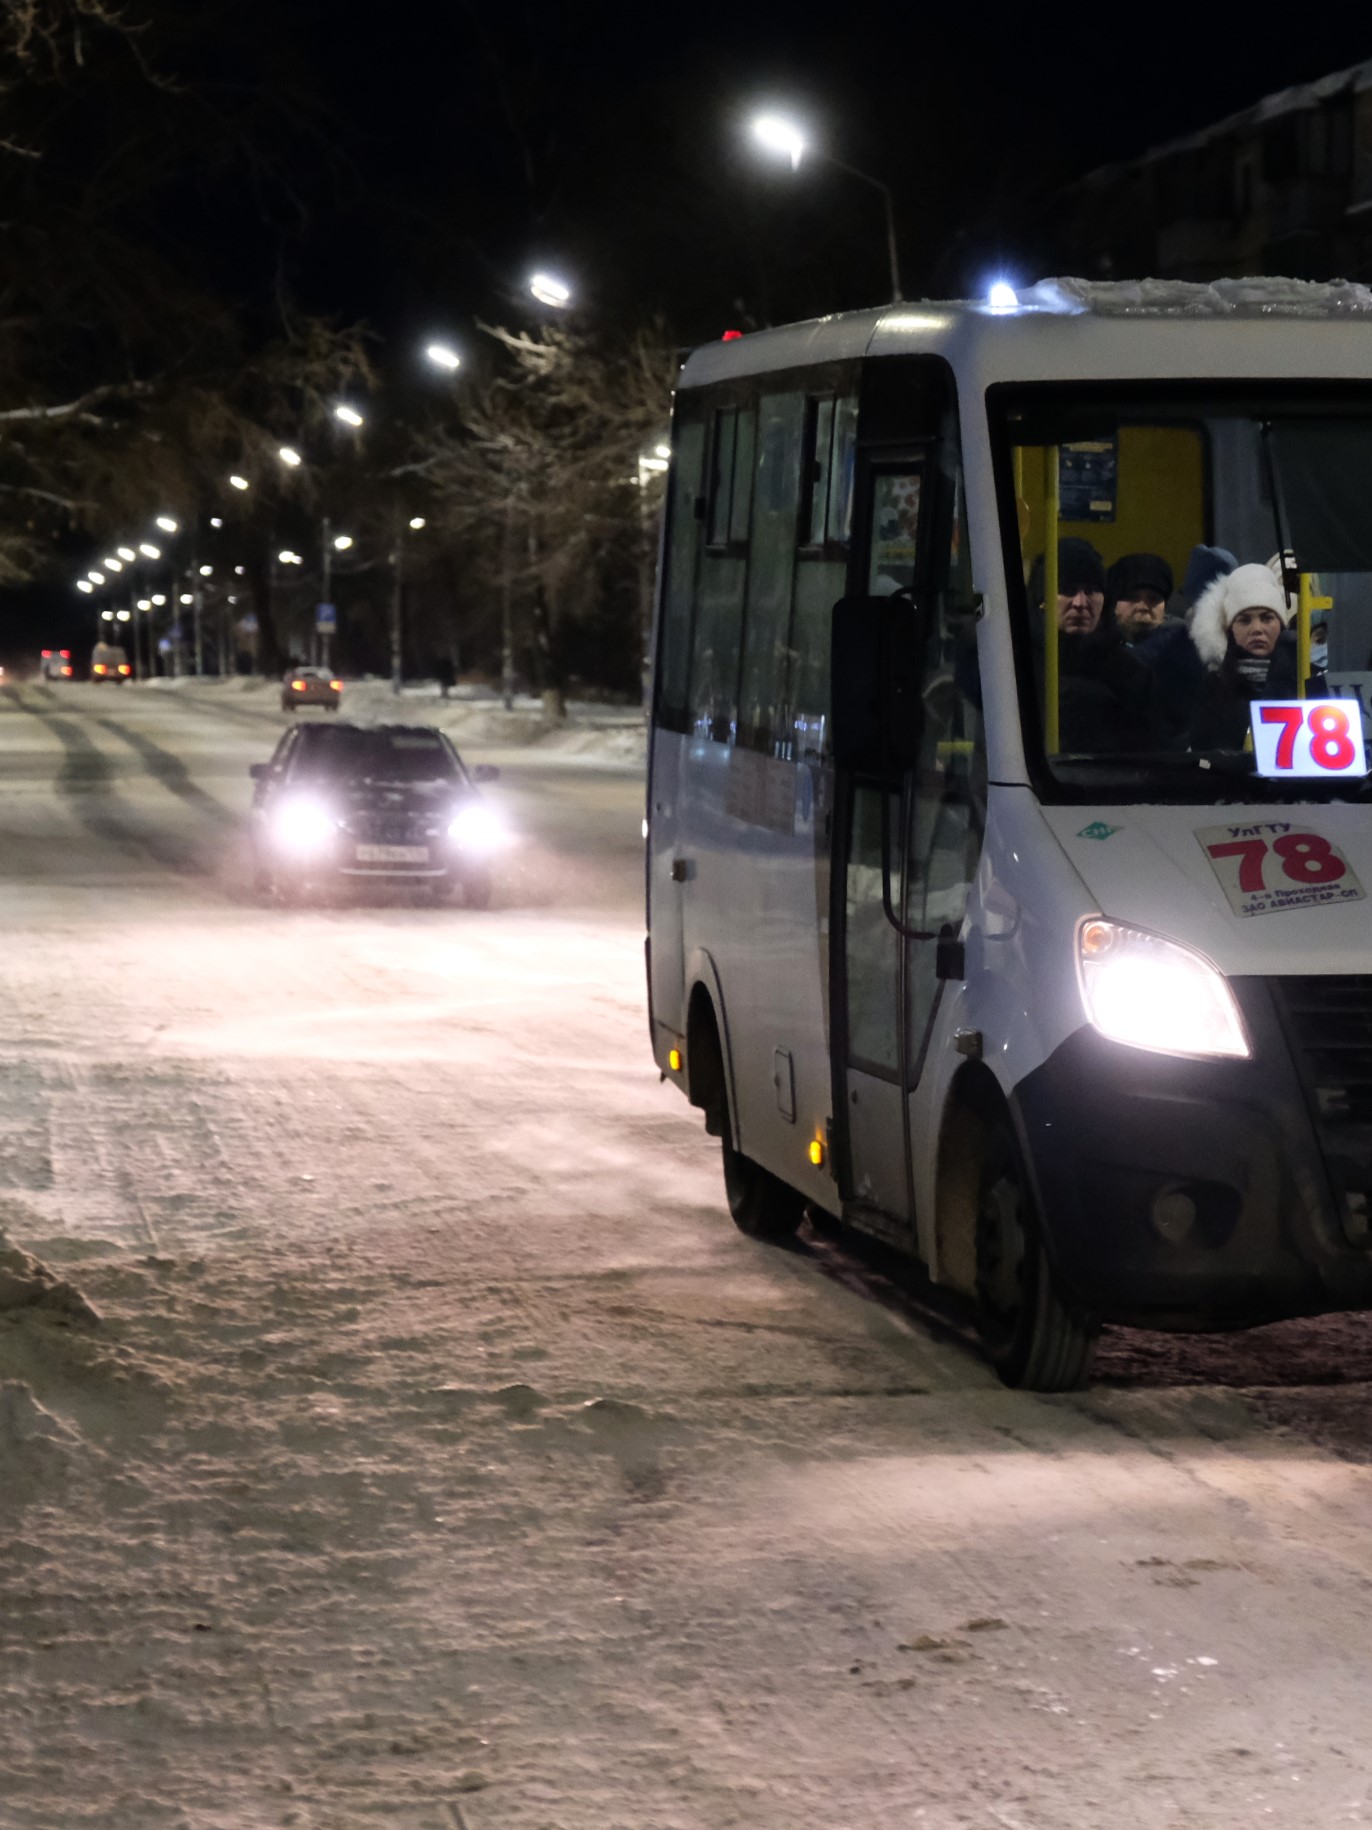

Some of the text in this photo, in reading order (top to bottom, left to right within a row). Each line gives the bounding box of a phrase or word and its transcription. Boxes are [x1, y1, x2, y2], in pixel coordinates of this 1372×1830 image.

[1260, 705, 1355, 770] 78
[1227, 822, 1292, 837] УлГТУ
[1207, 833, 1346, 893] 78
[1241, 902, 1265, 914] ЗАО
